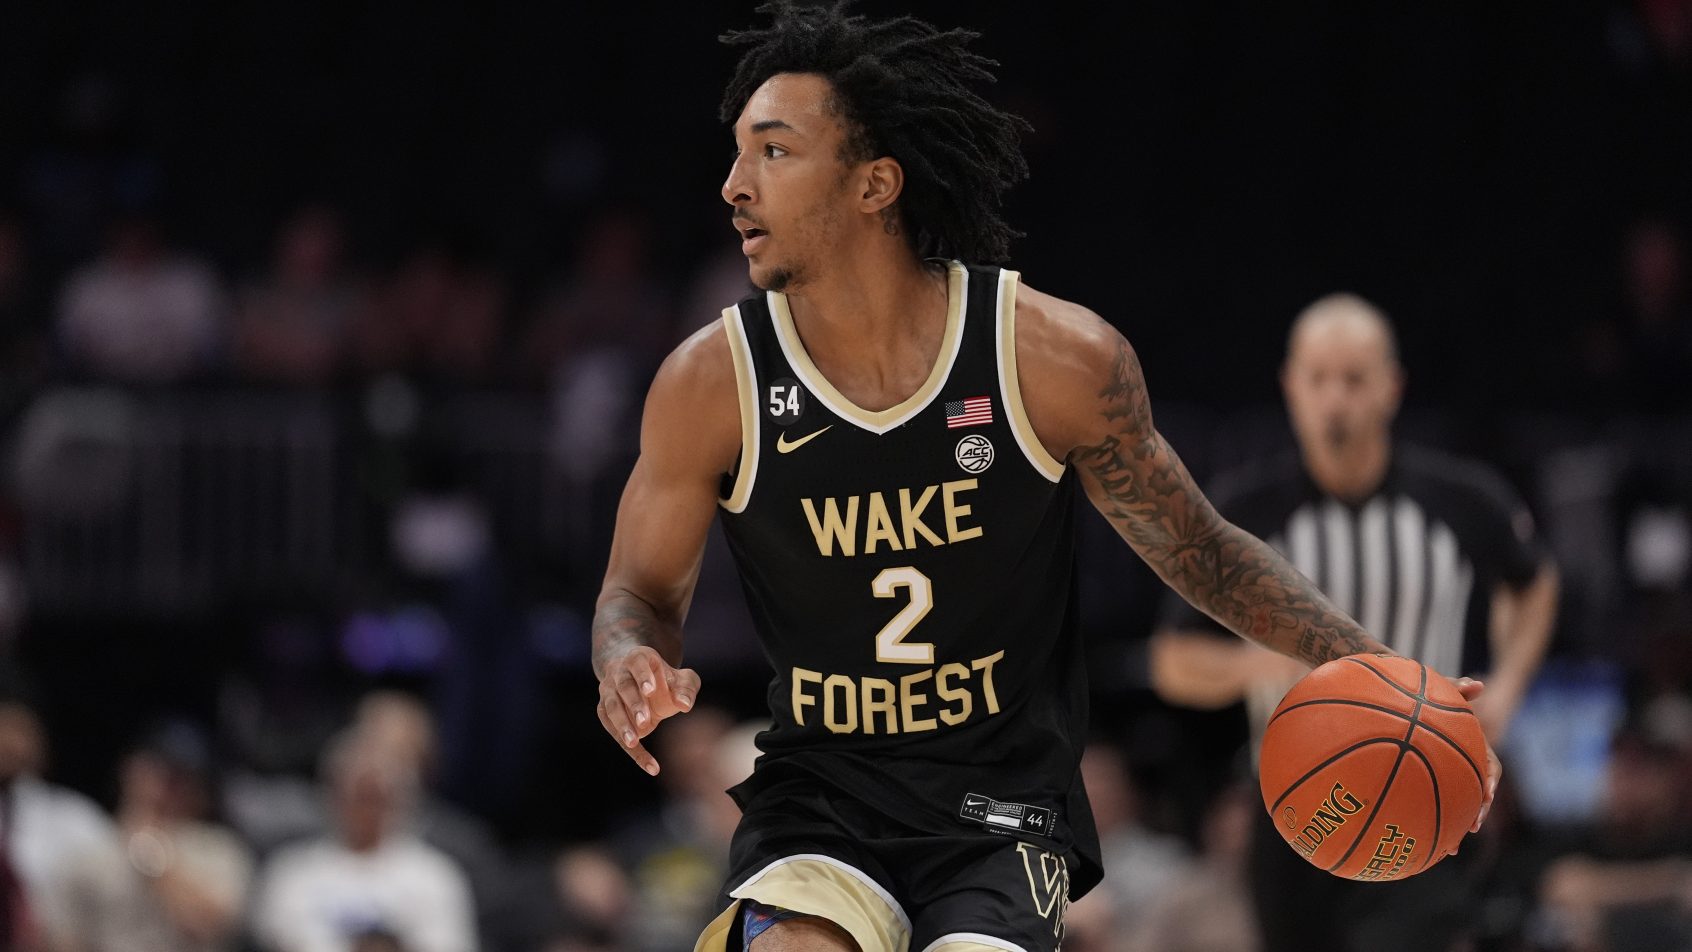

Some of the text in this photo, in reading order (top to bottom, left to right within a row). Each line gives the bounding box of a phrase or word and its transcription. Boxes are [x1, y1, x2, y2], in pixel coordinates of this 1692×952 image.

[769, 385, 800, 417] 54
[801, 478, 983, 557] WAKE
[872, 566, 935, 664] 2
[792, 650, 1004, 735] FOREST
[964, 807, 984, 816] TEAM
[1026, 813, 1043, 827] 44
[1290, 780, 1364, 859] ALDING
